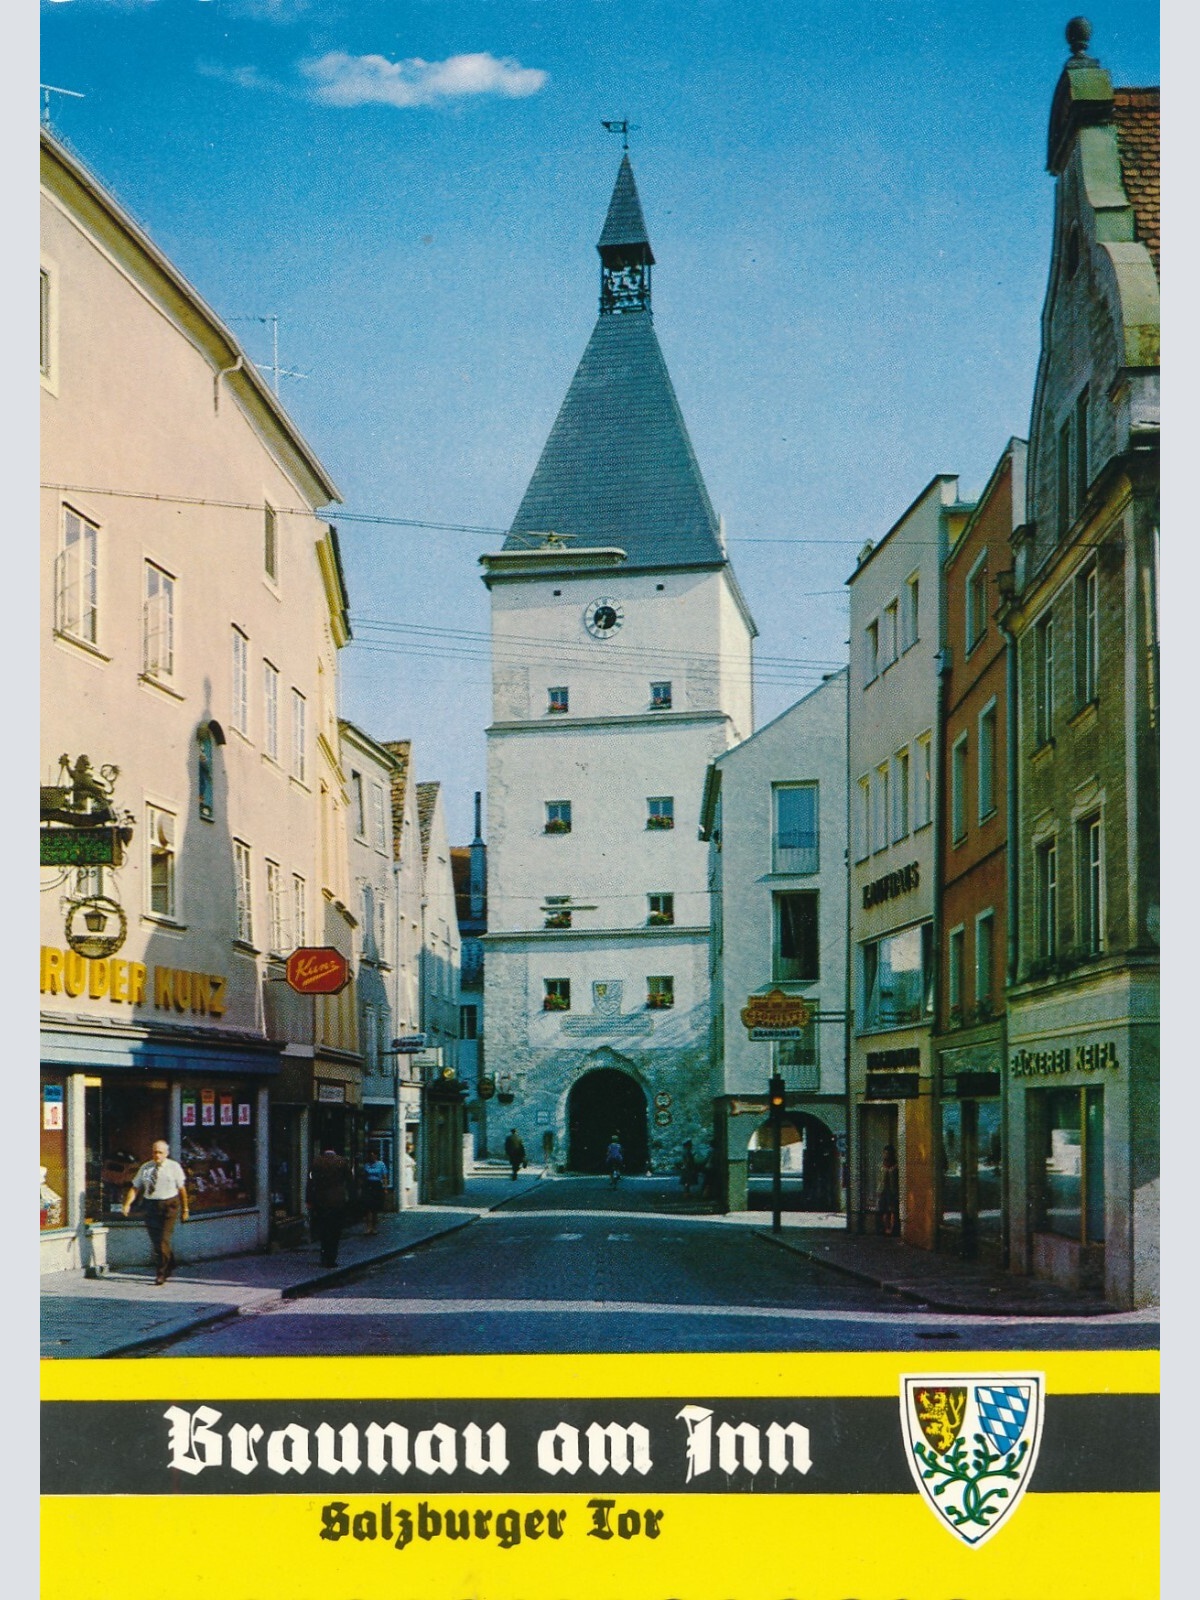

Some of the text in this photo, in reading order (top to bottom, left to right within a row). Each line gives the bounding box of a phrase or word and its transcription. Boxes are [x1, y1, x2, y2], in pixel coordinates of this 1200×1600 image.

[295, 956, 340, 986] Kunz
[154, 965, 228, 1015] KUNZ
[1009, 1048, 1071, 1077] BÄCKEREI
